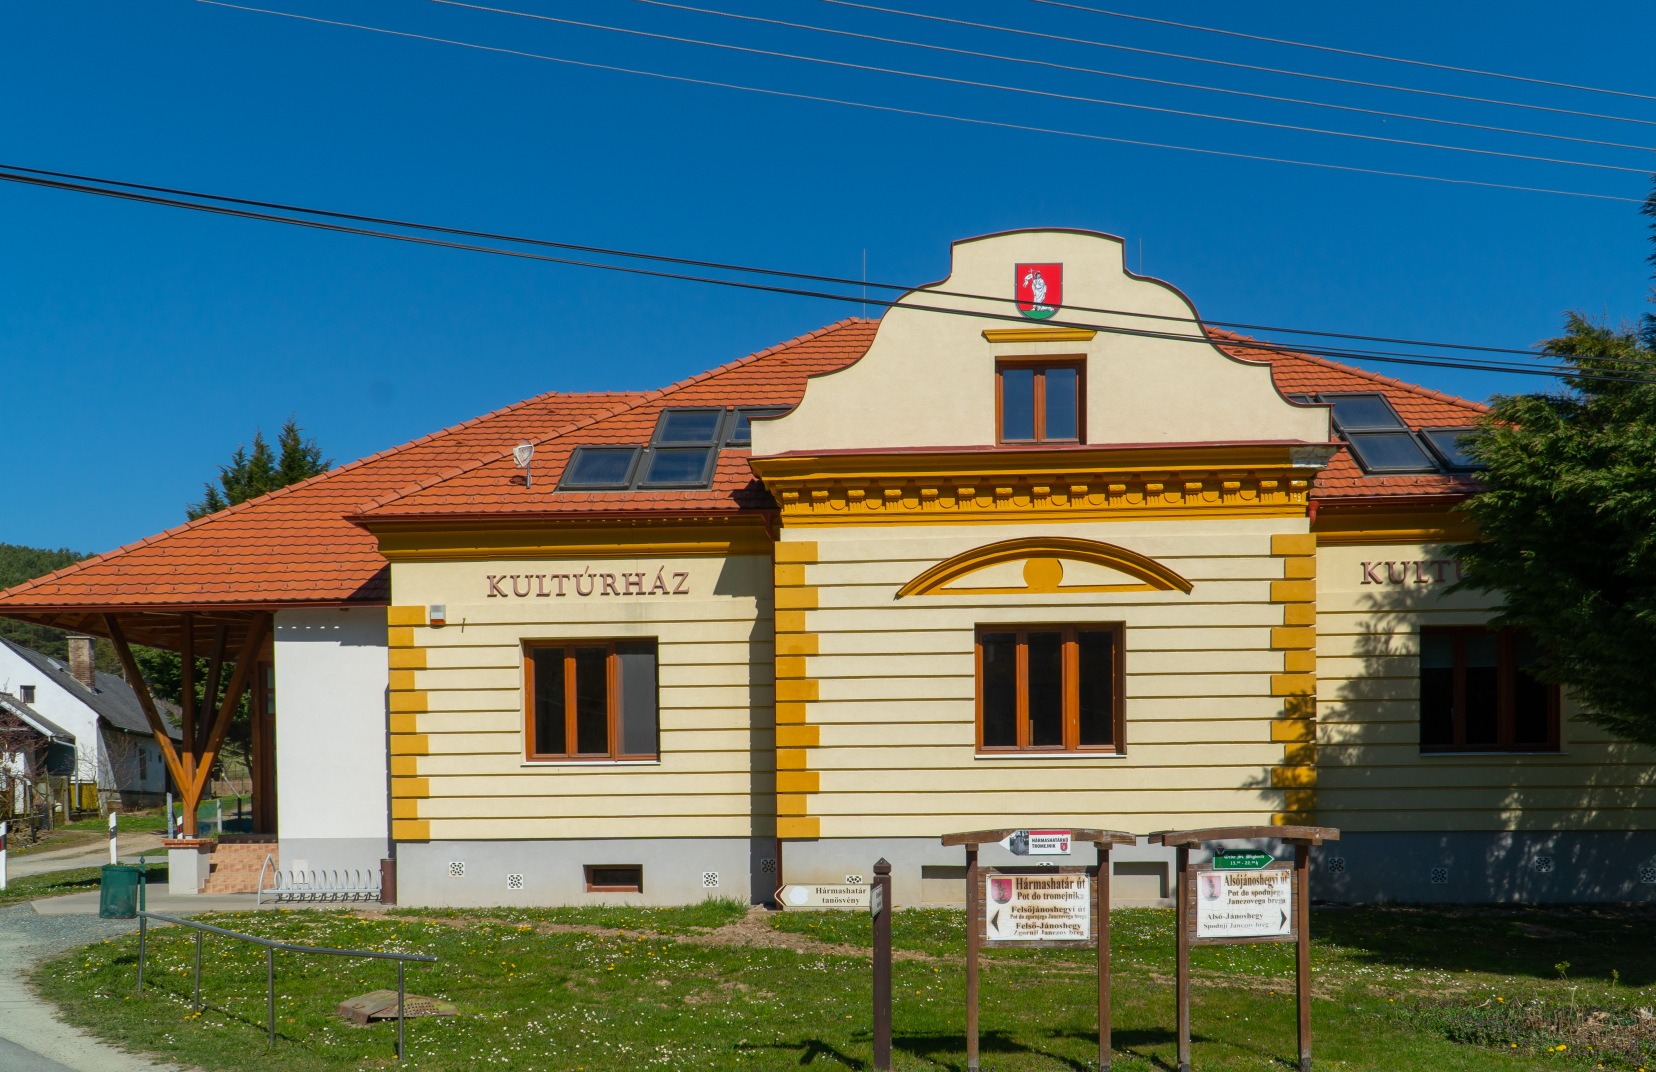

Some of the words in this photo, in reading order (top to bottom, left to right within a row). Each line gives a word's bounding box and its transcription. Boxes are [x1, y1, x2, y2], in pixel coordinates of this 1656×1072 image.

[486, 564, 690, 597] KULTÚRHÁZ
[1015, 877, 1075, 890] Hármashatár
[1076, 877, 1086, 890] út
[815, 887, 867, 895] Hármashatár
[1227, 889, 1239, 897] Pot
[1240, 889, 1250, 897] do
[822, 896, 860, 905] tanösvény
[1017, 891, 1030, 901] Pot
[1031, 891, 1042, 901] do
[1043, 891, 1085, 902] tromejnika
